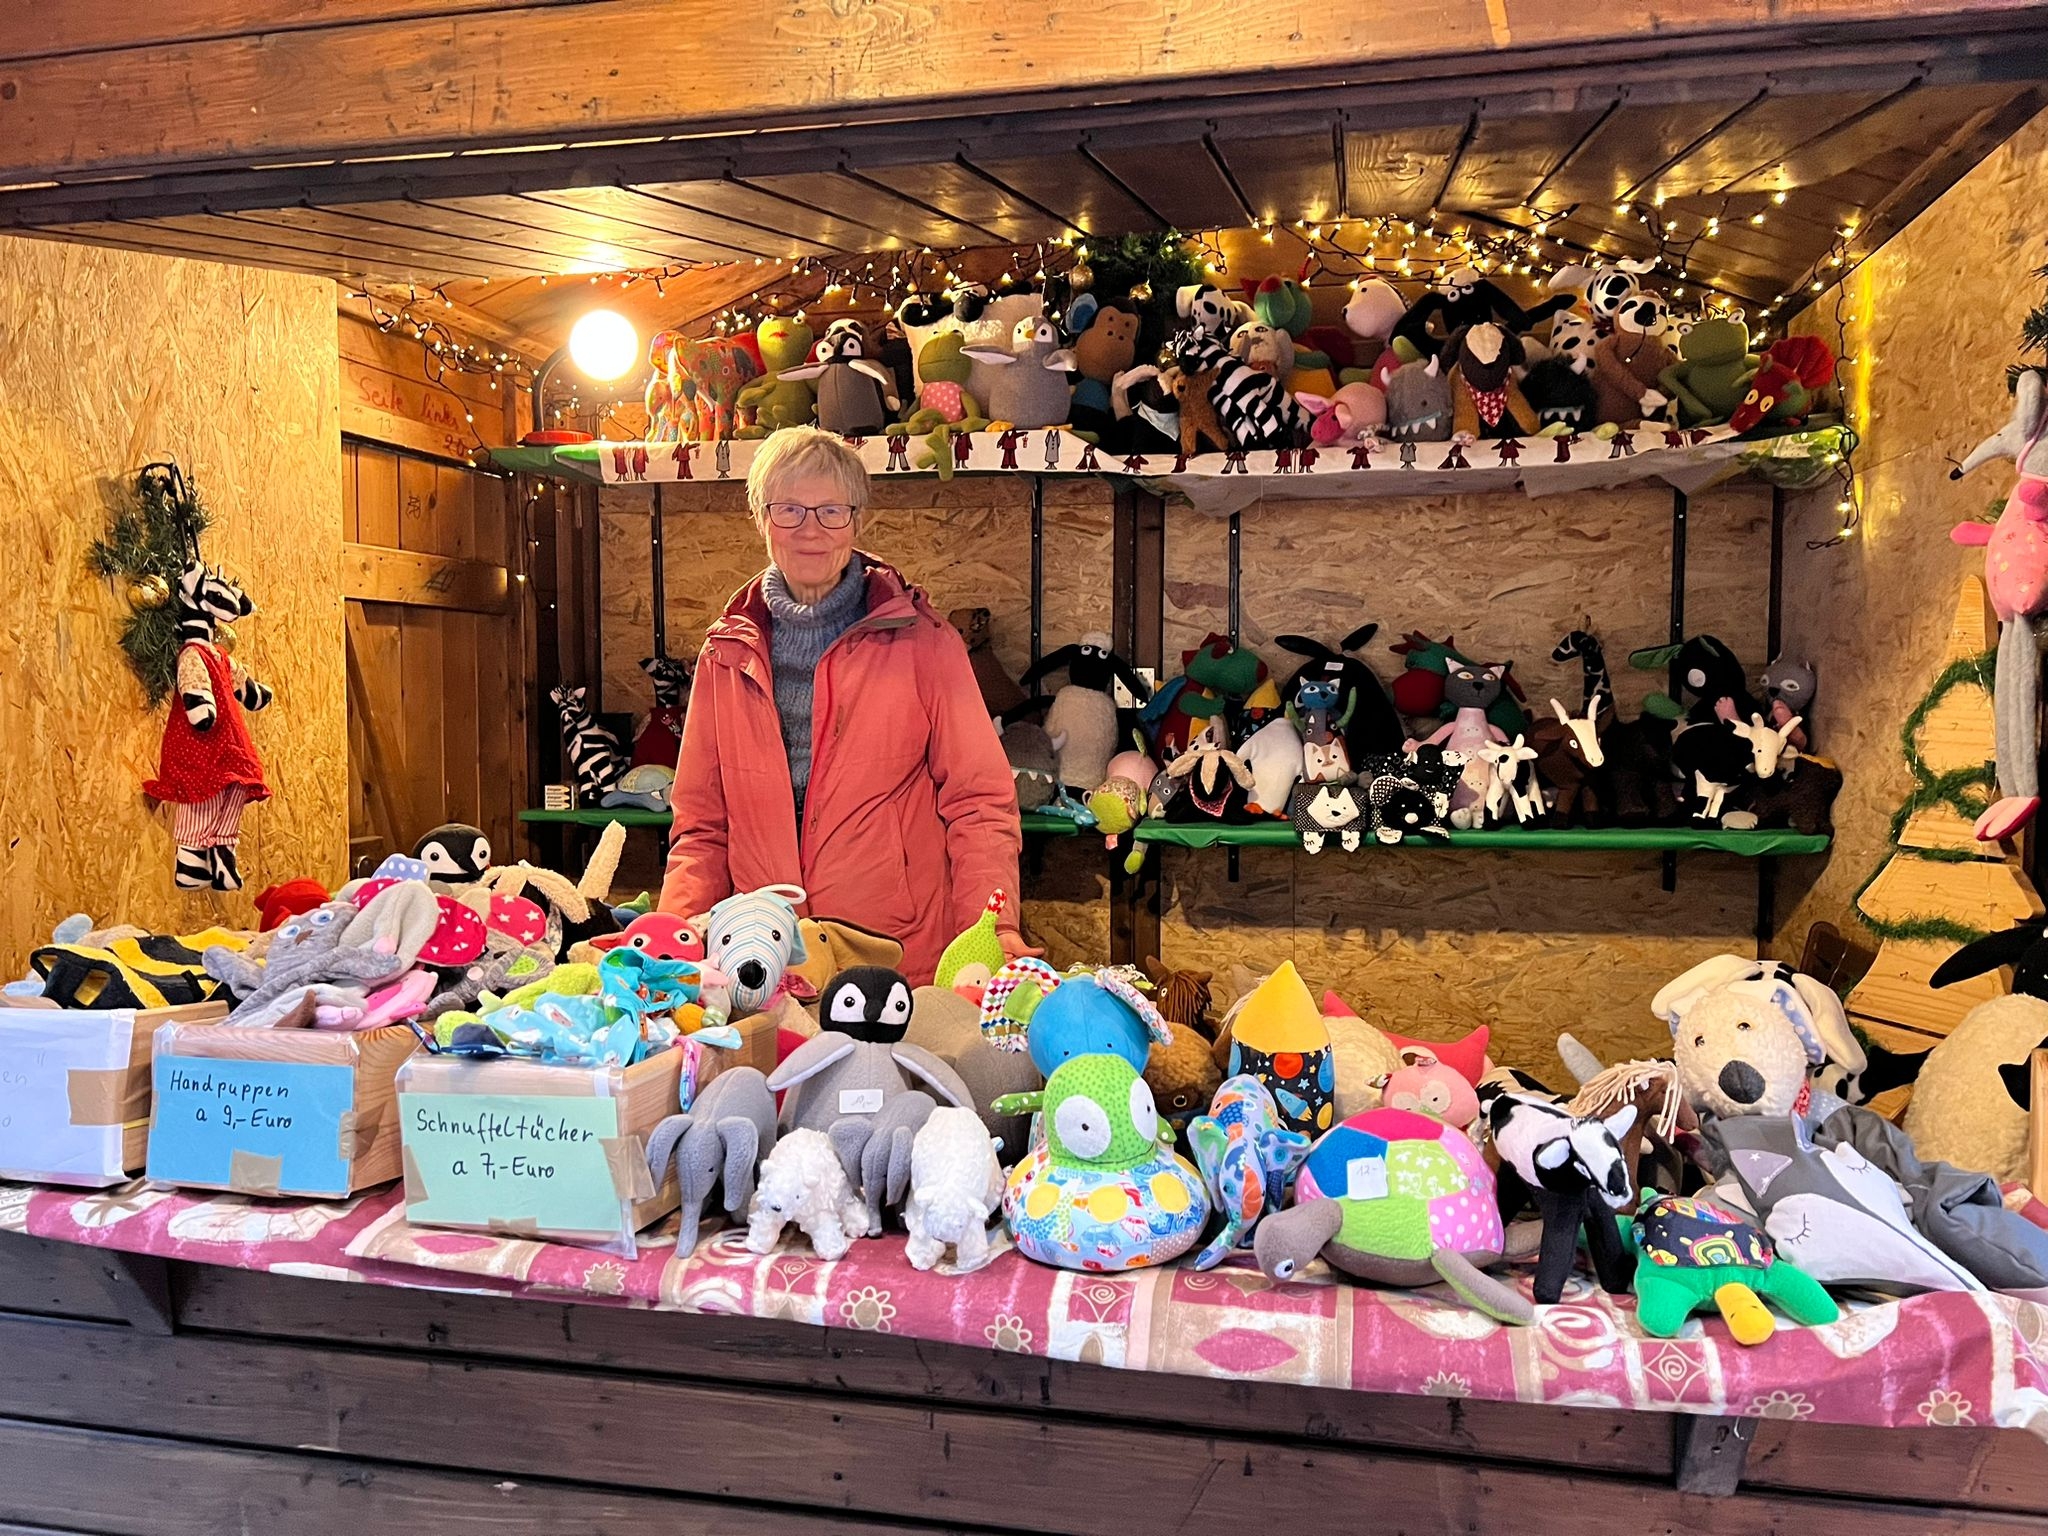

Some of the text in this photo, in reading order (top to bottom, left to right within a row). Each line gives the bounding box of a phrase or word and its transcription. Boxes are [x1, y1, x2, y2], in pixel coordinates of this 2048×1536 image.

[169, 1069, 290, 1104] Handpuppen
[195, 1107, 208, 1122] a
[416, 1107, 594, 1144] Schnuffeltücher
[451, 1159, 469, 1176] a
